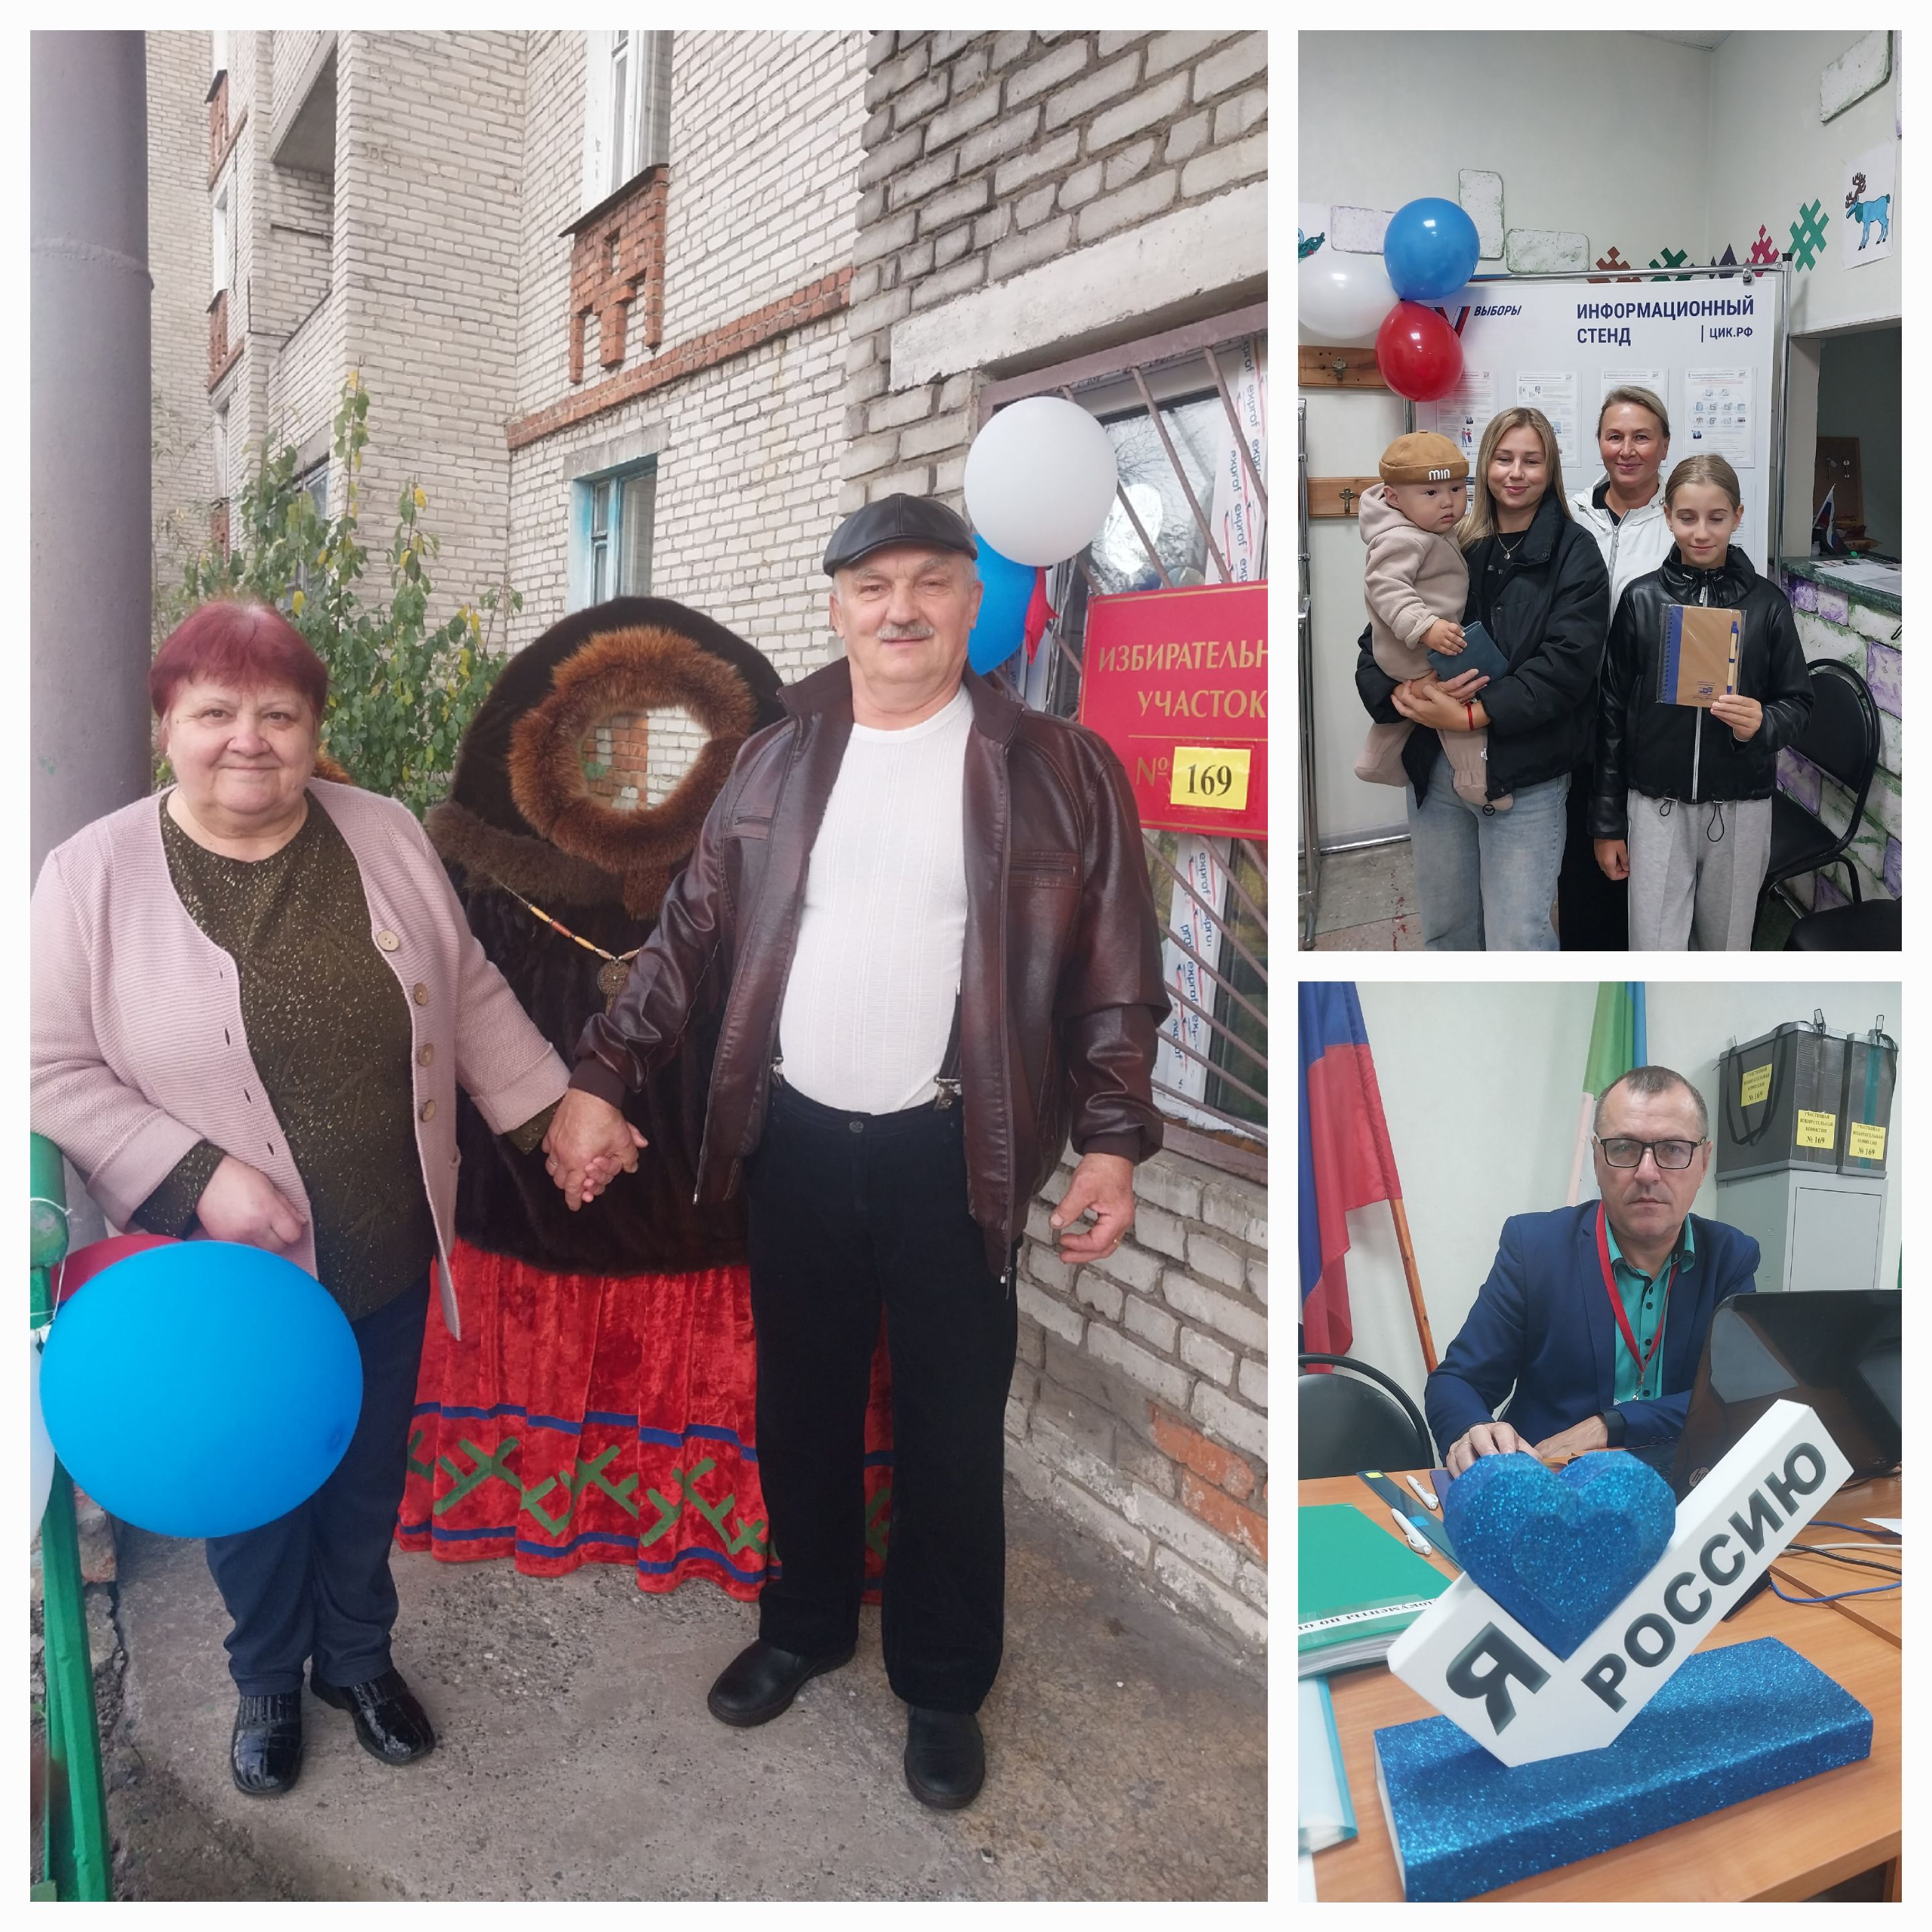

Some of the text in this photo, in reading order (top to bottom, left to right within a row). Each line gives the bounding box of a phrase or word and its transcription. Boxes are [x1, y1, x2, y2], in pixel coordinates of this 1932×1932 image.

[1473, 305, 1522, 317] ВЫБОРЫ
[1576, 294, 1754, 321] ИНФОРМАЦИОННЫЙ
[1576, 327, 1631, 347] СТЕНД
[1709, 326, 1754, 340] ЦИК.РФ
[1246, 384, 1260, 427] exprof
[1428, 468, 1450, 481] min
[1234, 503, 1248, 546] exprof
[1138, 690, 1267, 718] УЧАСТОК
[1185, 763, 1232, 796] 169
[1198, 852, 1211, 896] exprof
[1187, 961, 1199, 1004] exprof
[1755, 1091, 1763, 1099] 169
[1866, 1148, 1876, 1156] 169
[1580, 1442, 1827, 1713] РОССИЮ
[1446, 1621, 1552, 1736] Я
